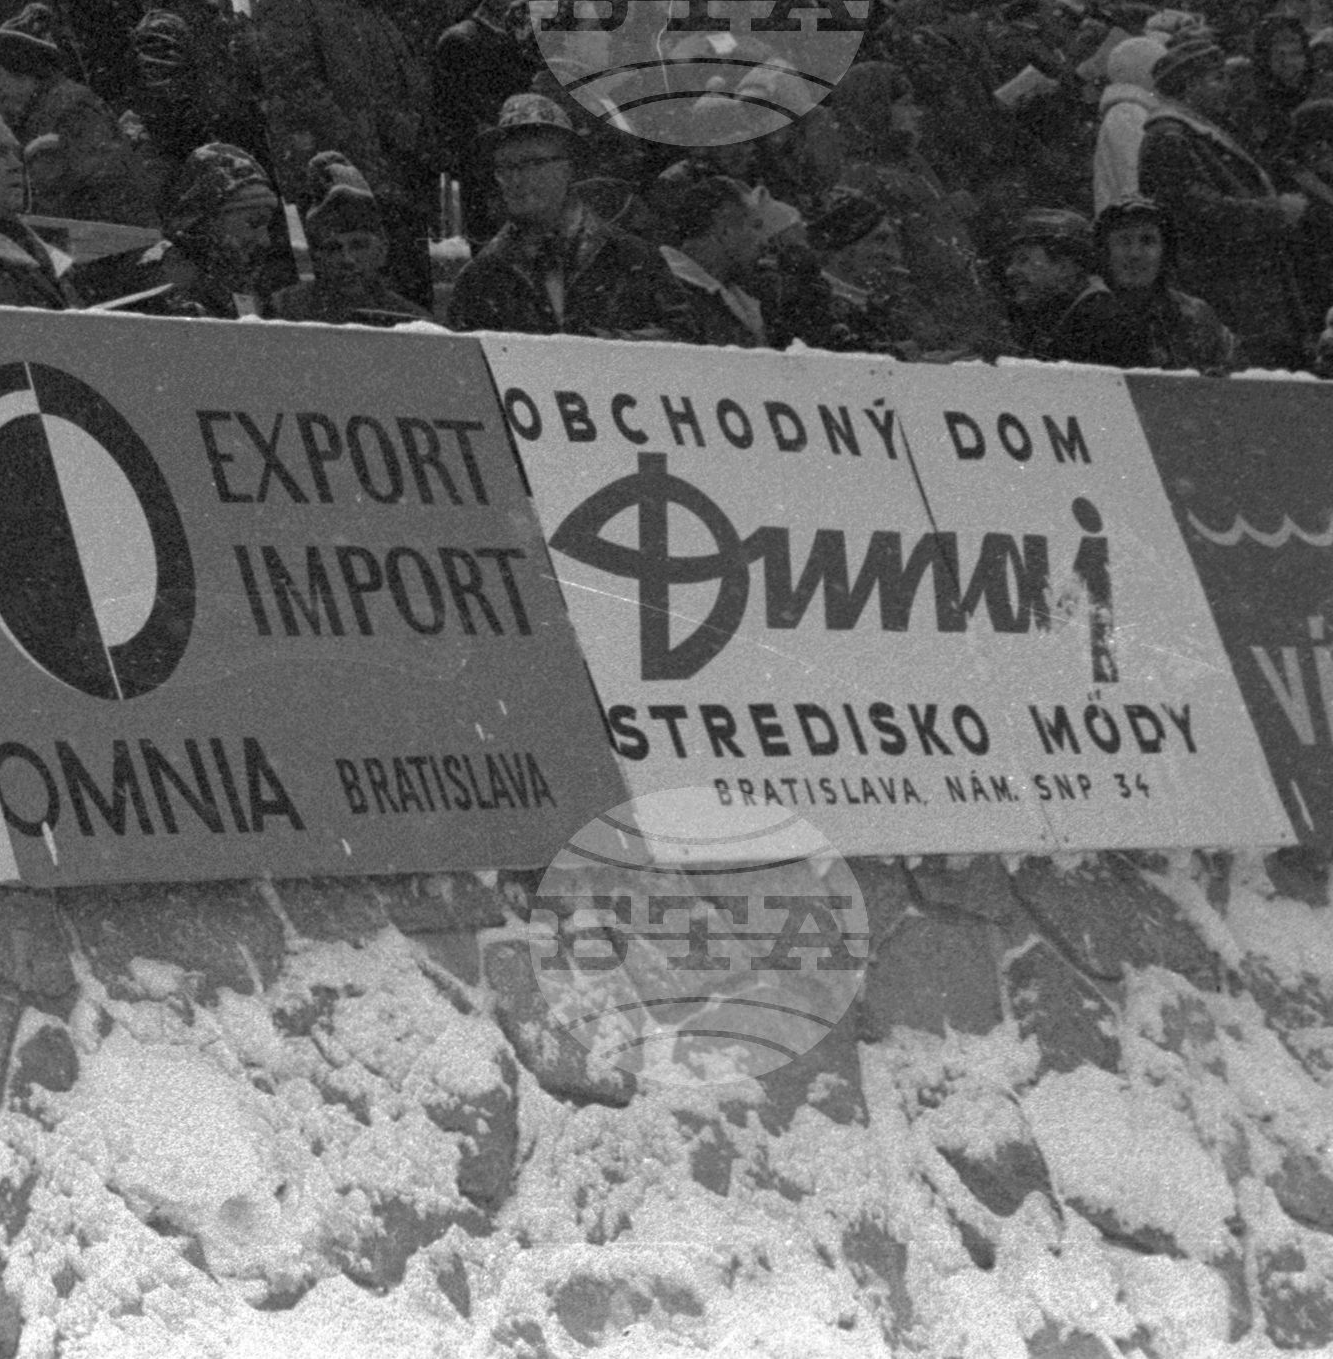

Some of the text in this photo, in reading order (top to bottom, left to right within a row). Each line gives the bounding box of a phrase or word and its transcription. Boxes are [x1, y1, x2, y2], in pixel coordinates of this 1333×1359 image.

[195, 410, 490, 507] EXPORT
[501, 386, 1093, 465] OBCHODNÝ DOM
[234, 545, 533, 637] IMPORT
[607, 702, 991, 761] STREDISKO
[335, 752, 558, 815] BRATISLAVA
[945, 770, 1019, 803] NÁM.
[1034, 773, 1093, 801] SNP
[1113, 772, 1150, 799] 34
